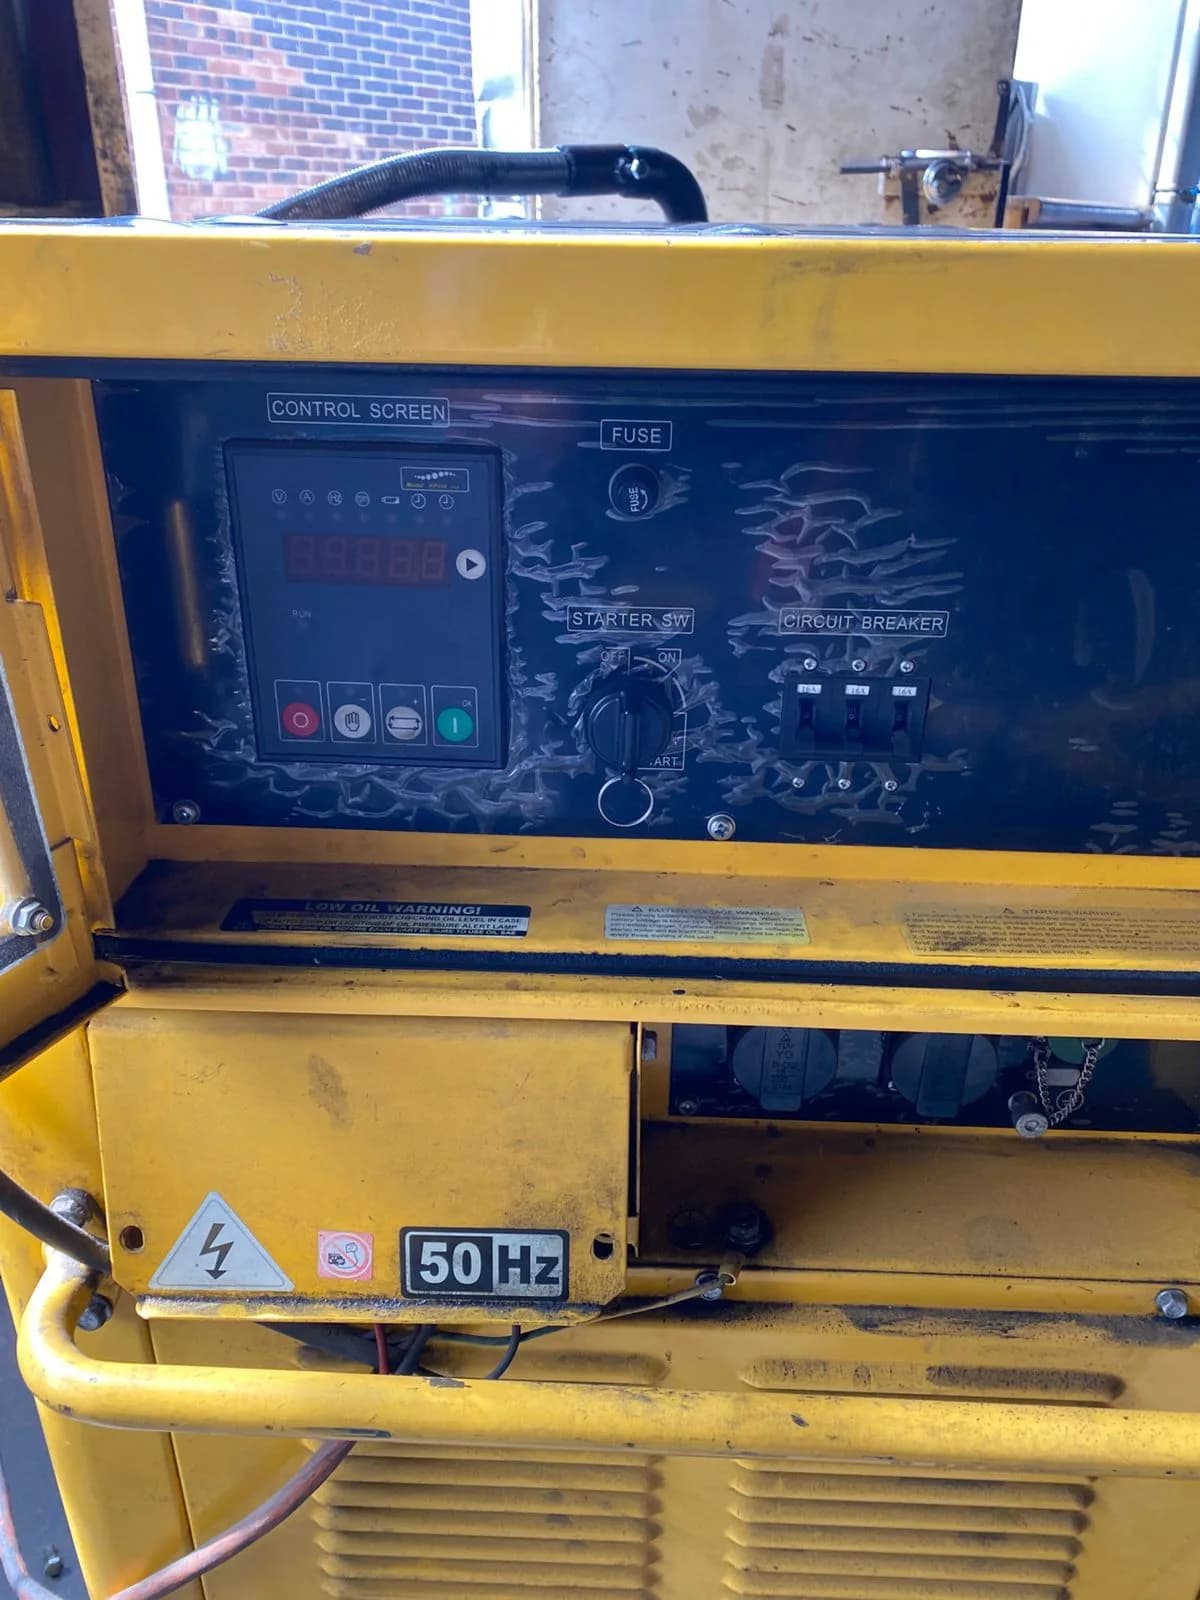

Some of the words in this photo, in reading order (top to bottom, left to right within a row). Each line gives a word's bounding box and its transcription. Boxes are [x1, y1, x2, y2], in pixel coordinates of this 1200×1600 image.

[271, 400, 361, 418] CONTROL
[369, 403, 446, 421] SCREEN
[612, 427, 662, 443] FUSE
[628, 487, 640, 512] FUSE
[572, 612, 652, 627] STARTER
[662, 614, 690, 628] SW
[784, 614, 853, 629] CIRCUIT
[861, 616, 944, 631] BREAKER
[601, 651, 625, 662] OFF
[658, 652, 676, 663] ON
[304, 902, 346, 911] LOW
[351, 903, 380, 912] OIL
[387, 903, 481, 915] WARNING!
[419, 1241, 482, 1285] 50
[498, 1244, 560, 1285] Hz
